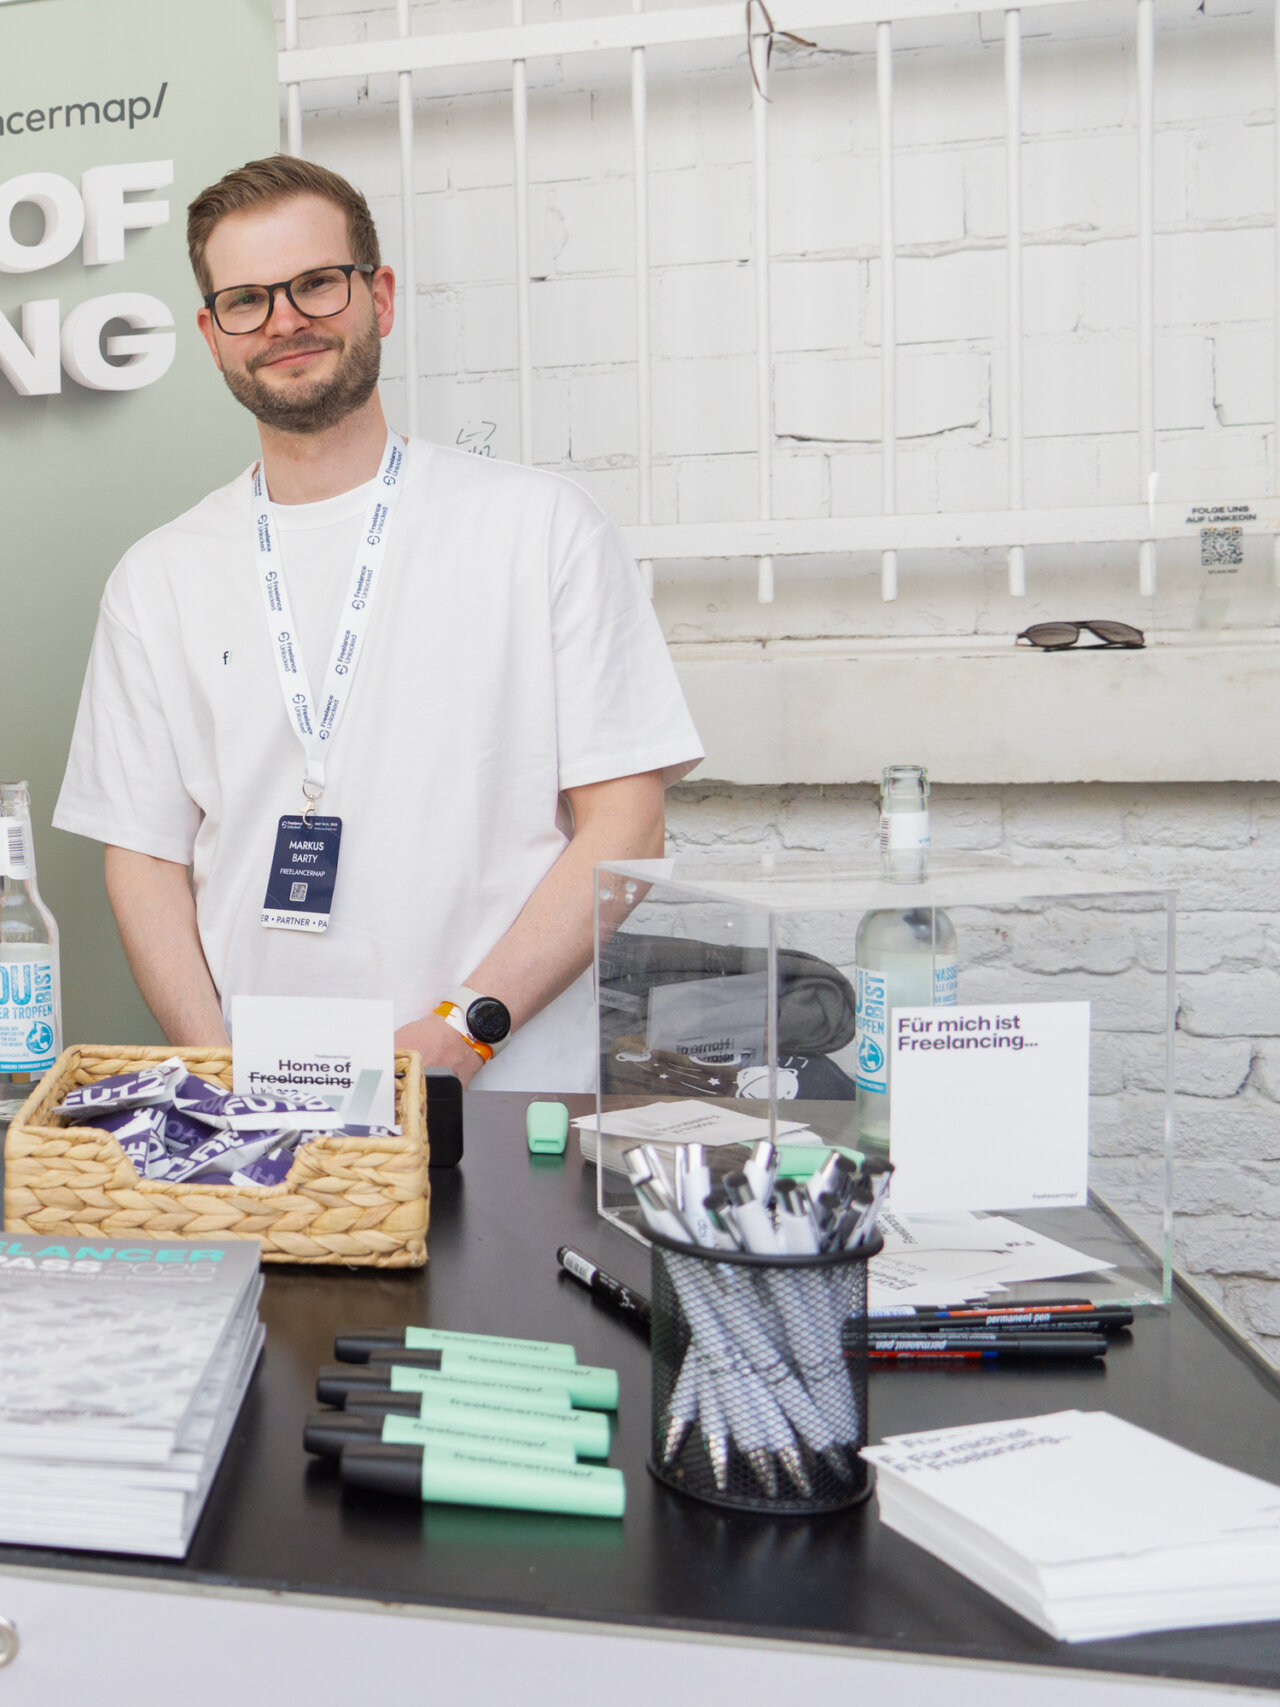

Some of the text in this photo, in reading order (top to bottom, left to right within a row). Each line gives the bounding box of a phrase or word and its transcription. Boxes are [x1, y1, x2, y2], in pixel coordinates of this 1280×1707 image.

[369, 503, 382, 534] Freelance
[354, 565, 367, 598] Freelance
[361, 569, 373, 599] Unlocked
[337, 630, 351, 663] Freelance
[345, 634, 358, 664] Unlocked
[320, 695, 334, 728] Freelance
[289, 840, 324, 851] MARKUS
[292, 853, 318, 864] BARTY
[280, 867, 326, 877] FREELANCERMAP
[276, 915, 311, 926] PARTNER
[33, 963, 52, 1004] BIST
[865, 971, 885, 1020] BIST
[12, 1004, 53, 1019] TROPFEN
[898, 1015, 1021, 1033] Für mich ist
[898, 1033, 1038, 1051] Freelancing...
[278, 1059, 351, 1073] Home of
[249, 1071, 351, 1089] Freelancing
[104, 1260, 217, 1276] 2025
[985, 1314, 1032, 1331] permanent
[1033, 1312, 1051, 1326] pen
[875, 1339, 947, 1351] permanent pen
